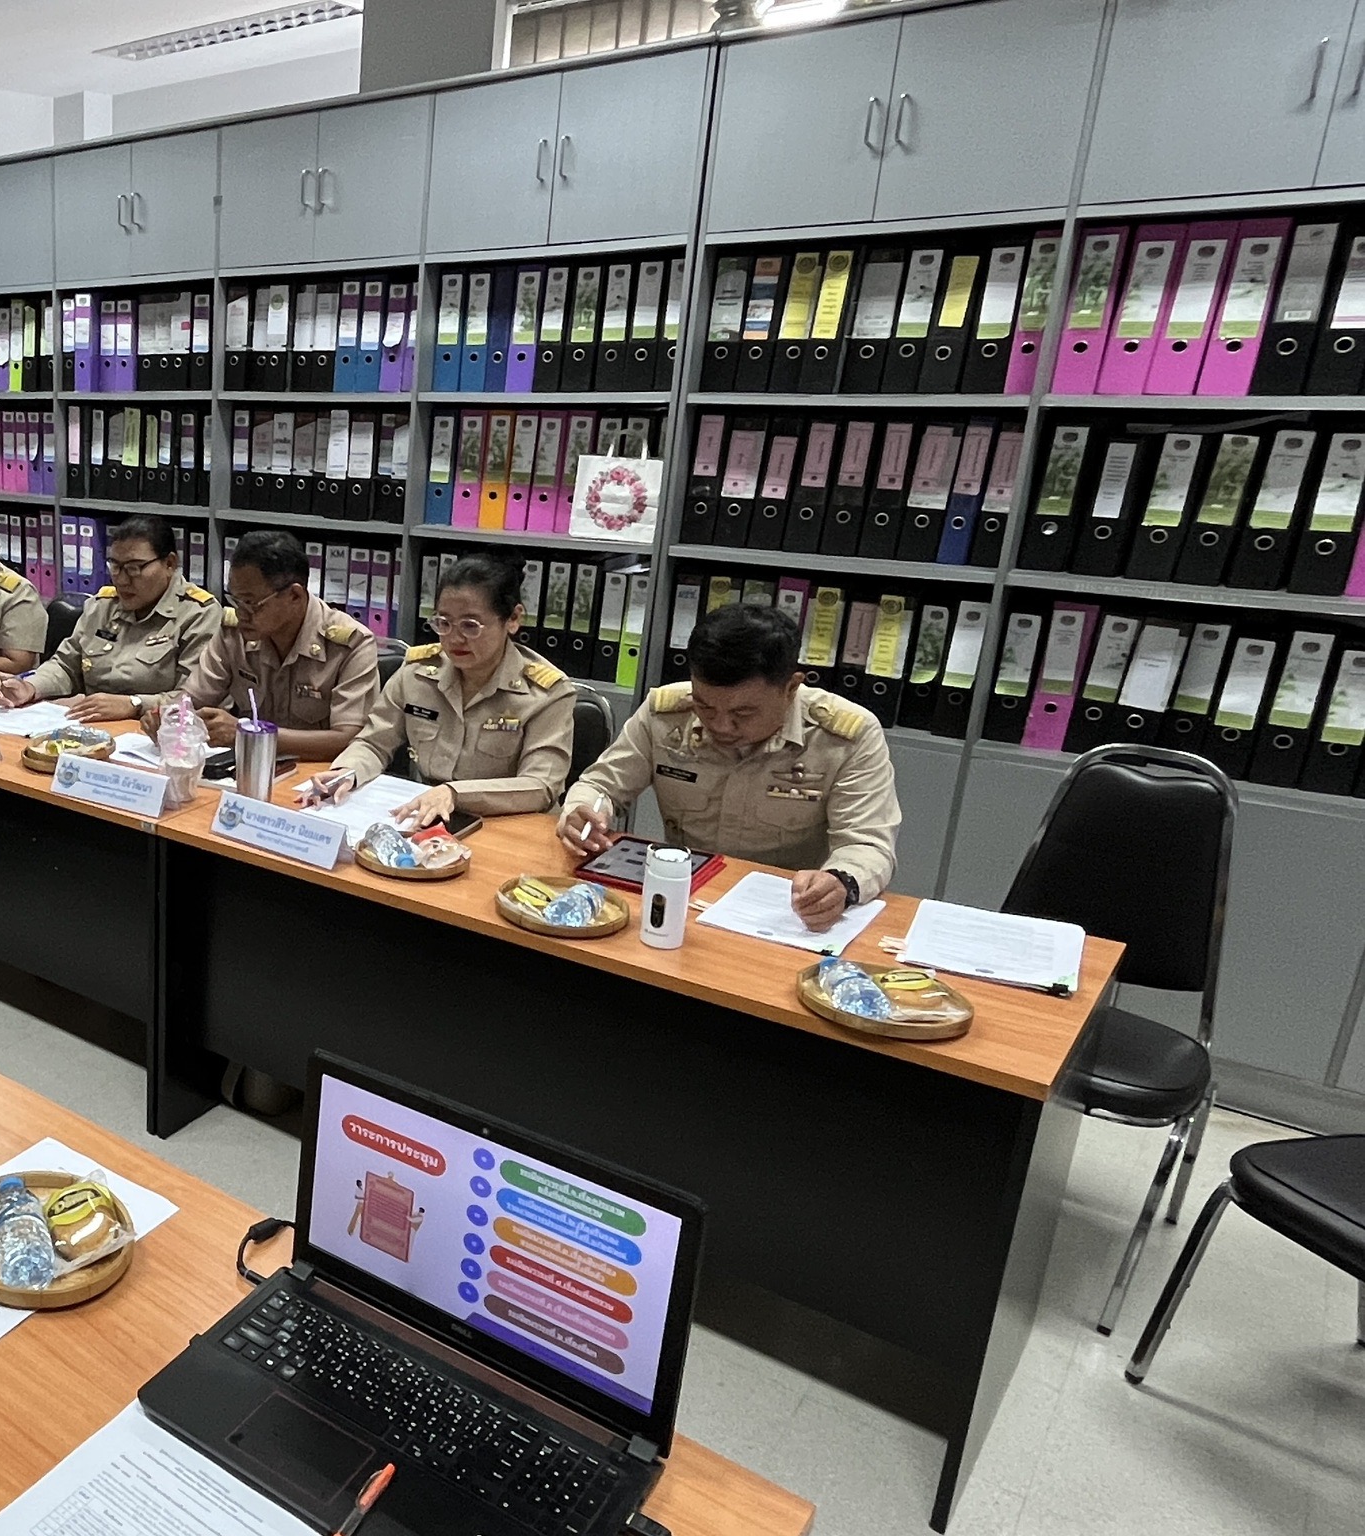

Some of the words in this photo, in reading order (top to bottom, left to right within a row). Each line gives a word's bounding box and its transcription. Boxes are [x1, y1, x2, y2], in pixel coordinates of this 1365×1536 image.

[349, 1121, 439, 1168] วาระการประชุม
